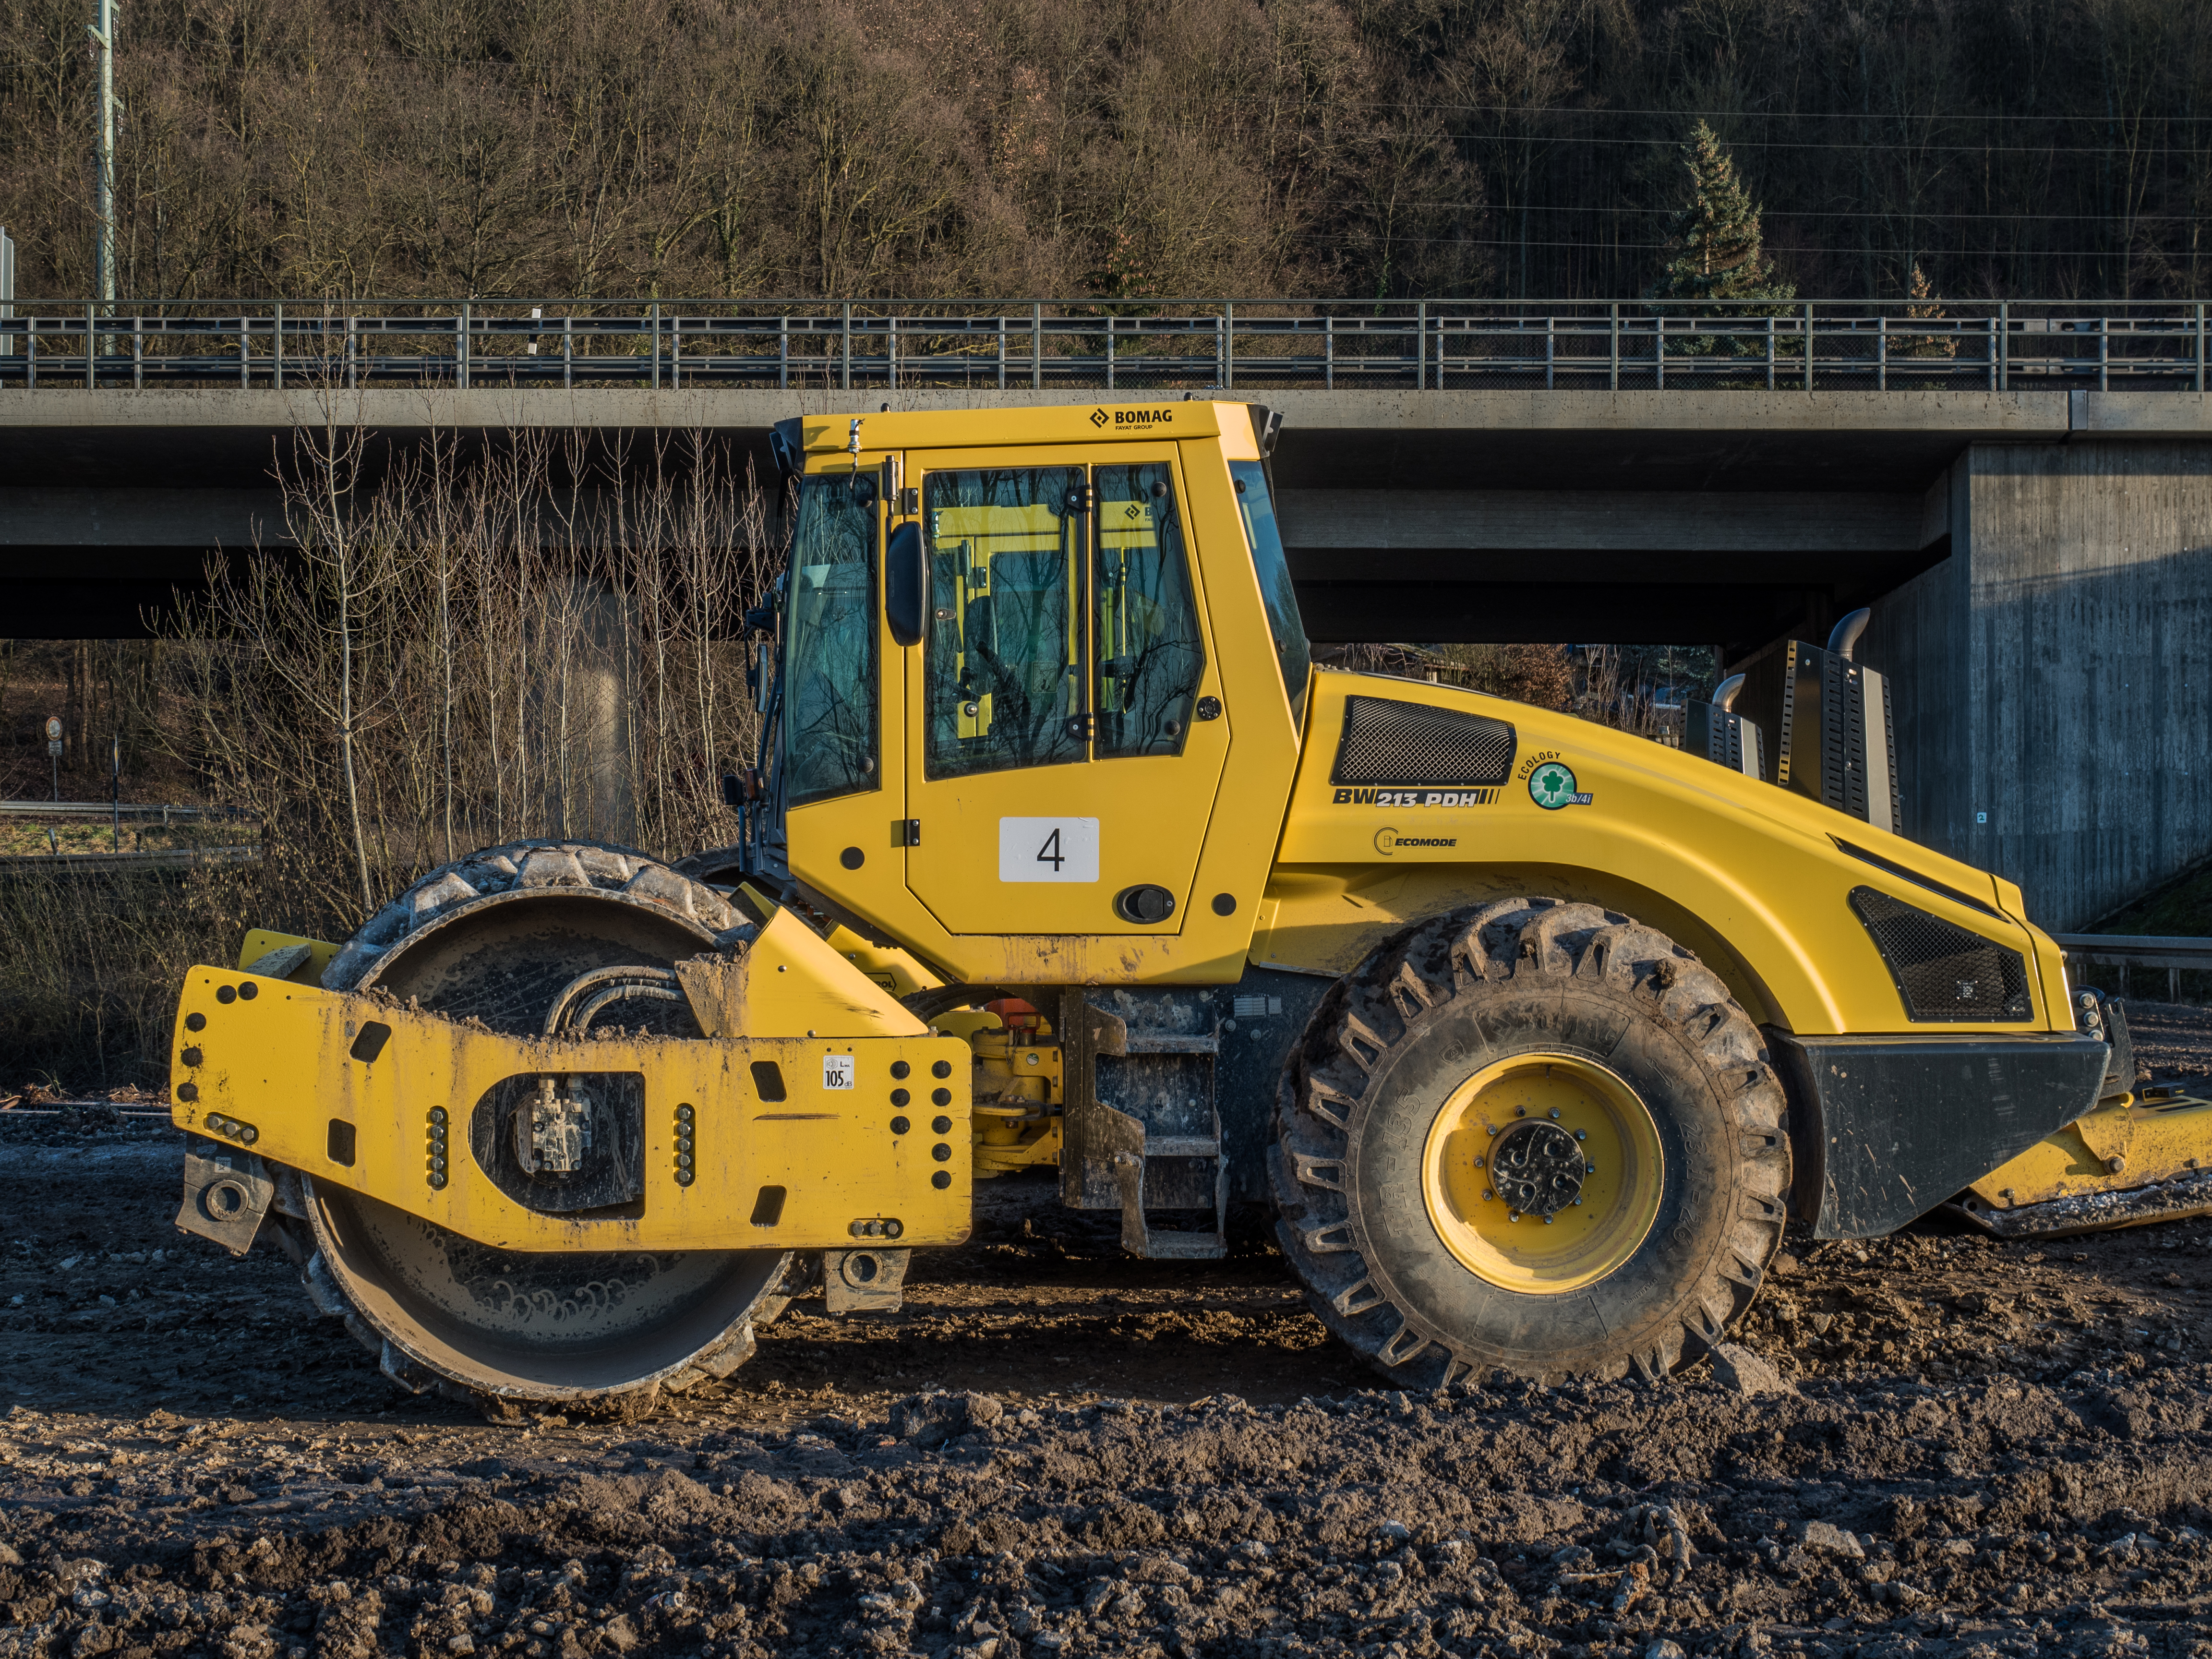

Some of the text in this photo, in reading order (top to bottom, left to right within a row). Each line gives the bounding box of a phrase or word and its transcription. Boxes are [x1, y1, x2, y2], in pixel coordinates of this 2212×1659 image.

[1115, 409, 1172, 423] BOMAG
[1517, 751, 1561, 781] ECOLOGY
[1424, 793, 1479, 807] PDH
[1566, 794, 1591, 803] 3b/4i
[1037, 828, 1065, 872] 4
[1395, 838, 1457, 847] ECOMODE
[1516, 1011, 1620, 1046] BOMAG
[826, 1070, 844, 1087] 105
